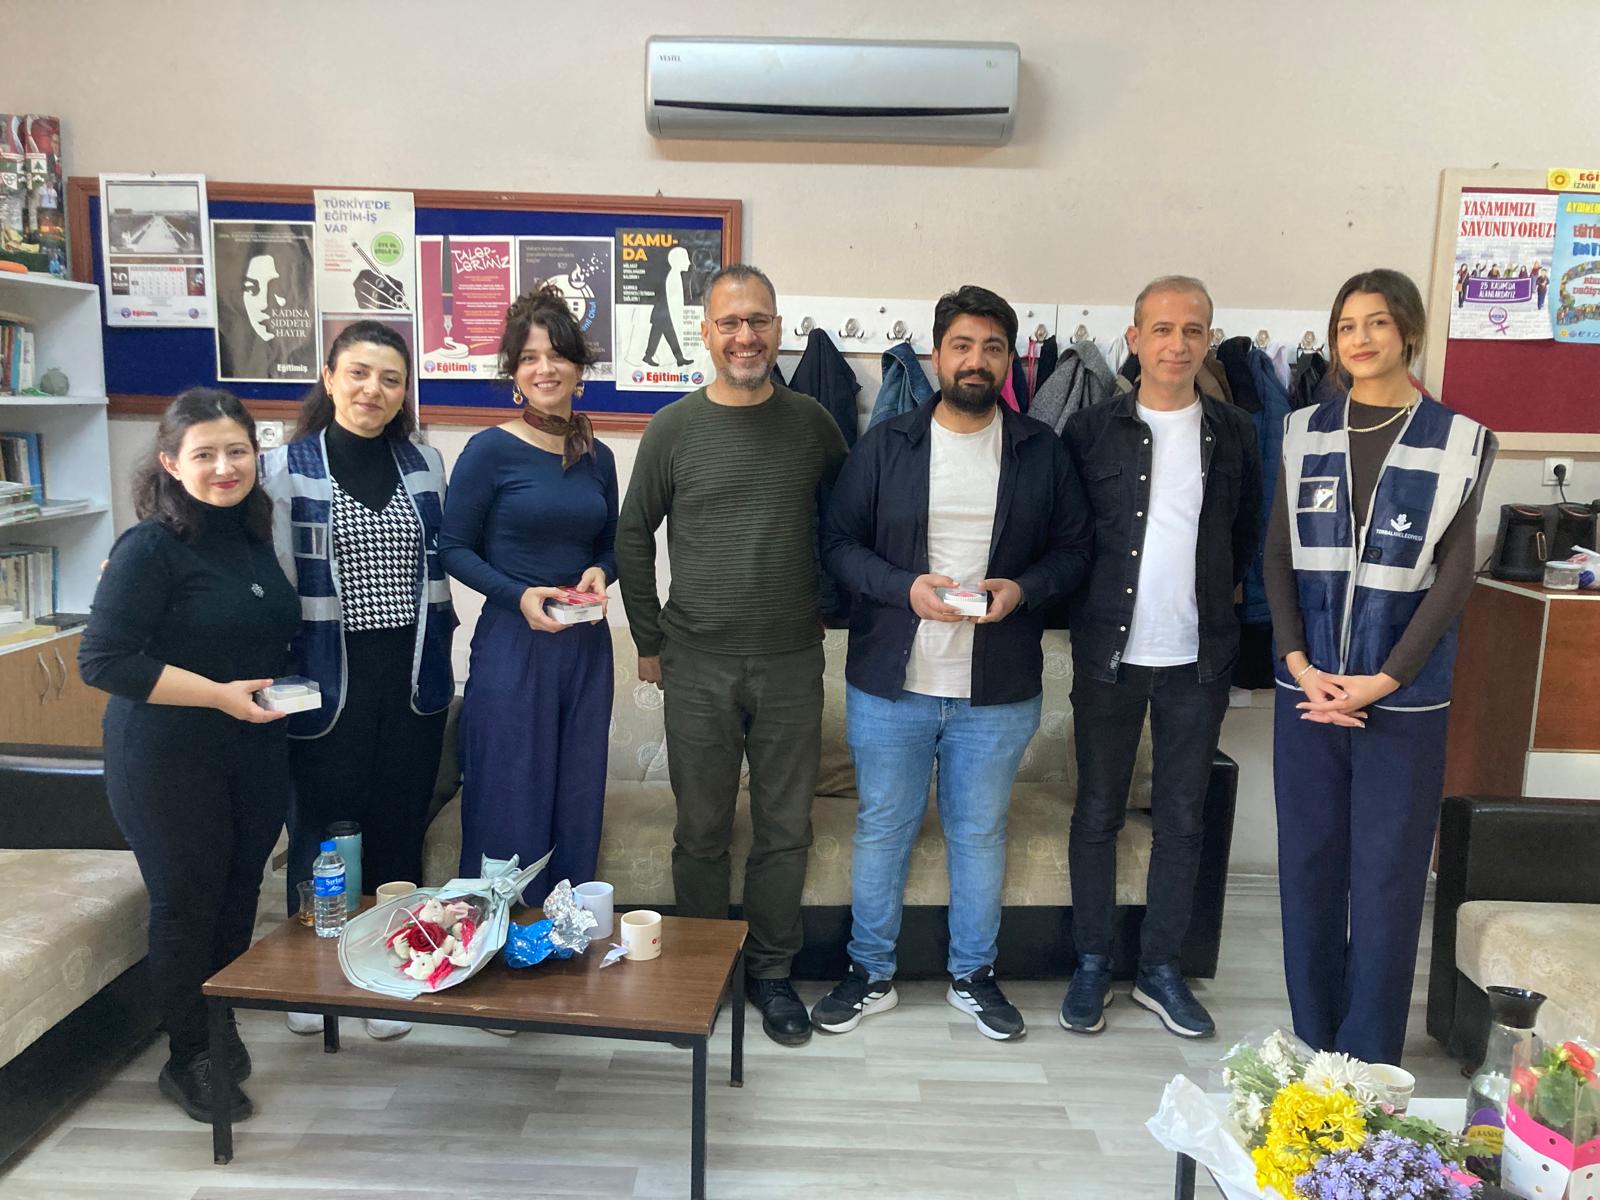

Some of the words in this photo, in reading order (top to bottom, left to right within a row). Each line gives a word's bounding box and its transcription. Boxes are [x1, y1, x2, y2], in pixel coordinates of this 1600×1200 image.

[323, 197, 391, 210] TÜRKİYE'DE
[1464, 200, 1536, 219] YAŞAMIMIZI
[324, 210, 378, 224] EĞİTİM-İŞ
[324, 224, 348, 233] VAR
[1460, 221, 1557, 238] SAVUNUYORUZ!
[622, 233, 679, 247] KAMU-
[622, 248, 648, 261] DA
[272, 309, 310, 318] KADINA
[276, 329, 307, 338] HAYIR
[436, 362, 477, 374] Eğitimiş
[646, 371, 689, 384] Eğitimiş
